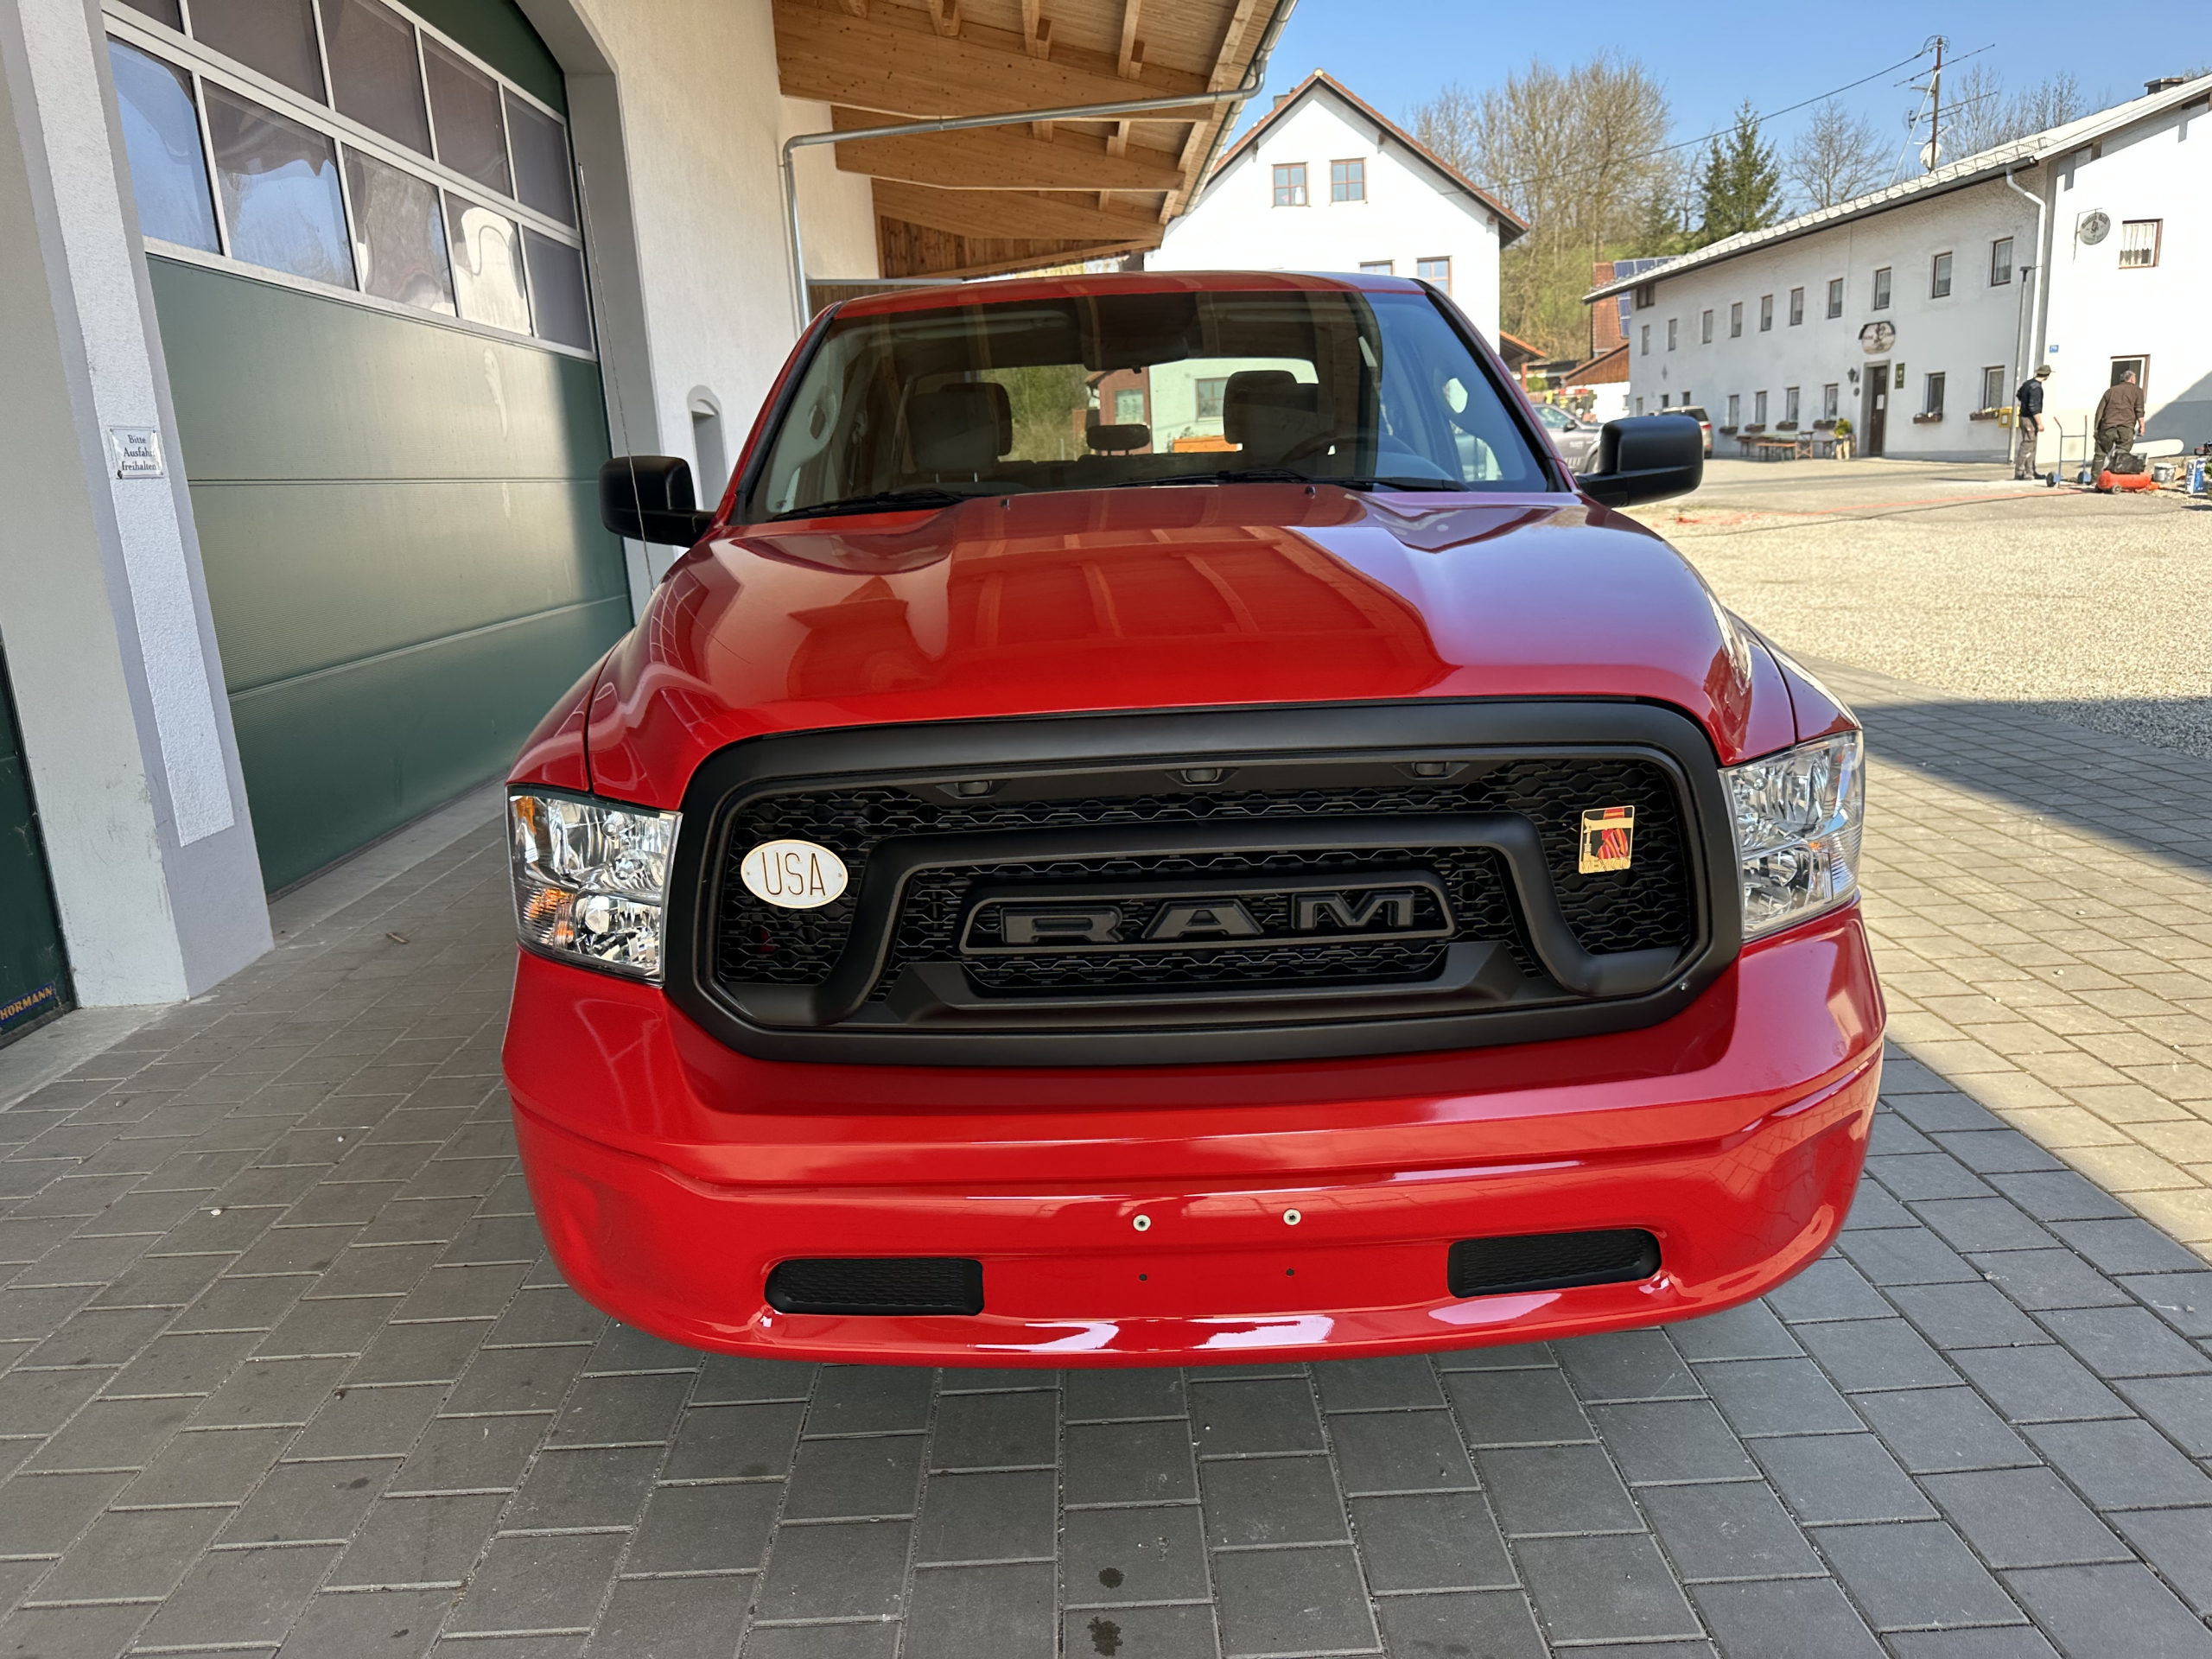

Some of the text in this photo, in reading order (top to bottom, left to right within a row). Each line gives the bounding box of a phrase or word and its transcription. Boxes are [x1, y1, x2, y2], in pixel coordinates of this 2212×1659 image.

[127, 434, 146, 444] Bitte
[761, 851, 826, 896] USA
[1580, 856, 1631, 874] MEXICO
[1000, 889, 1415, 944] RAM
